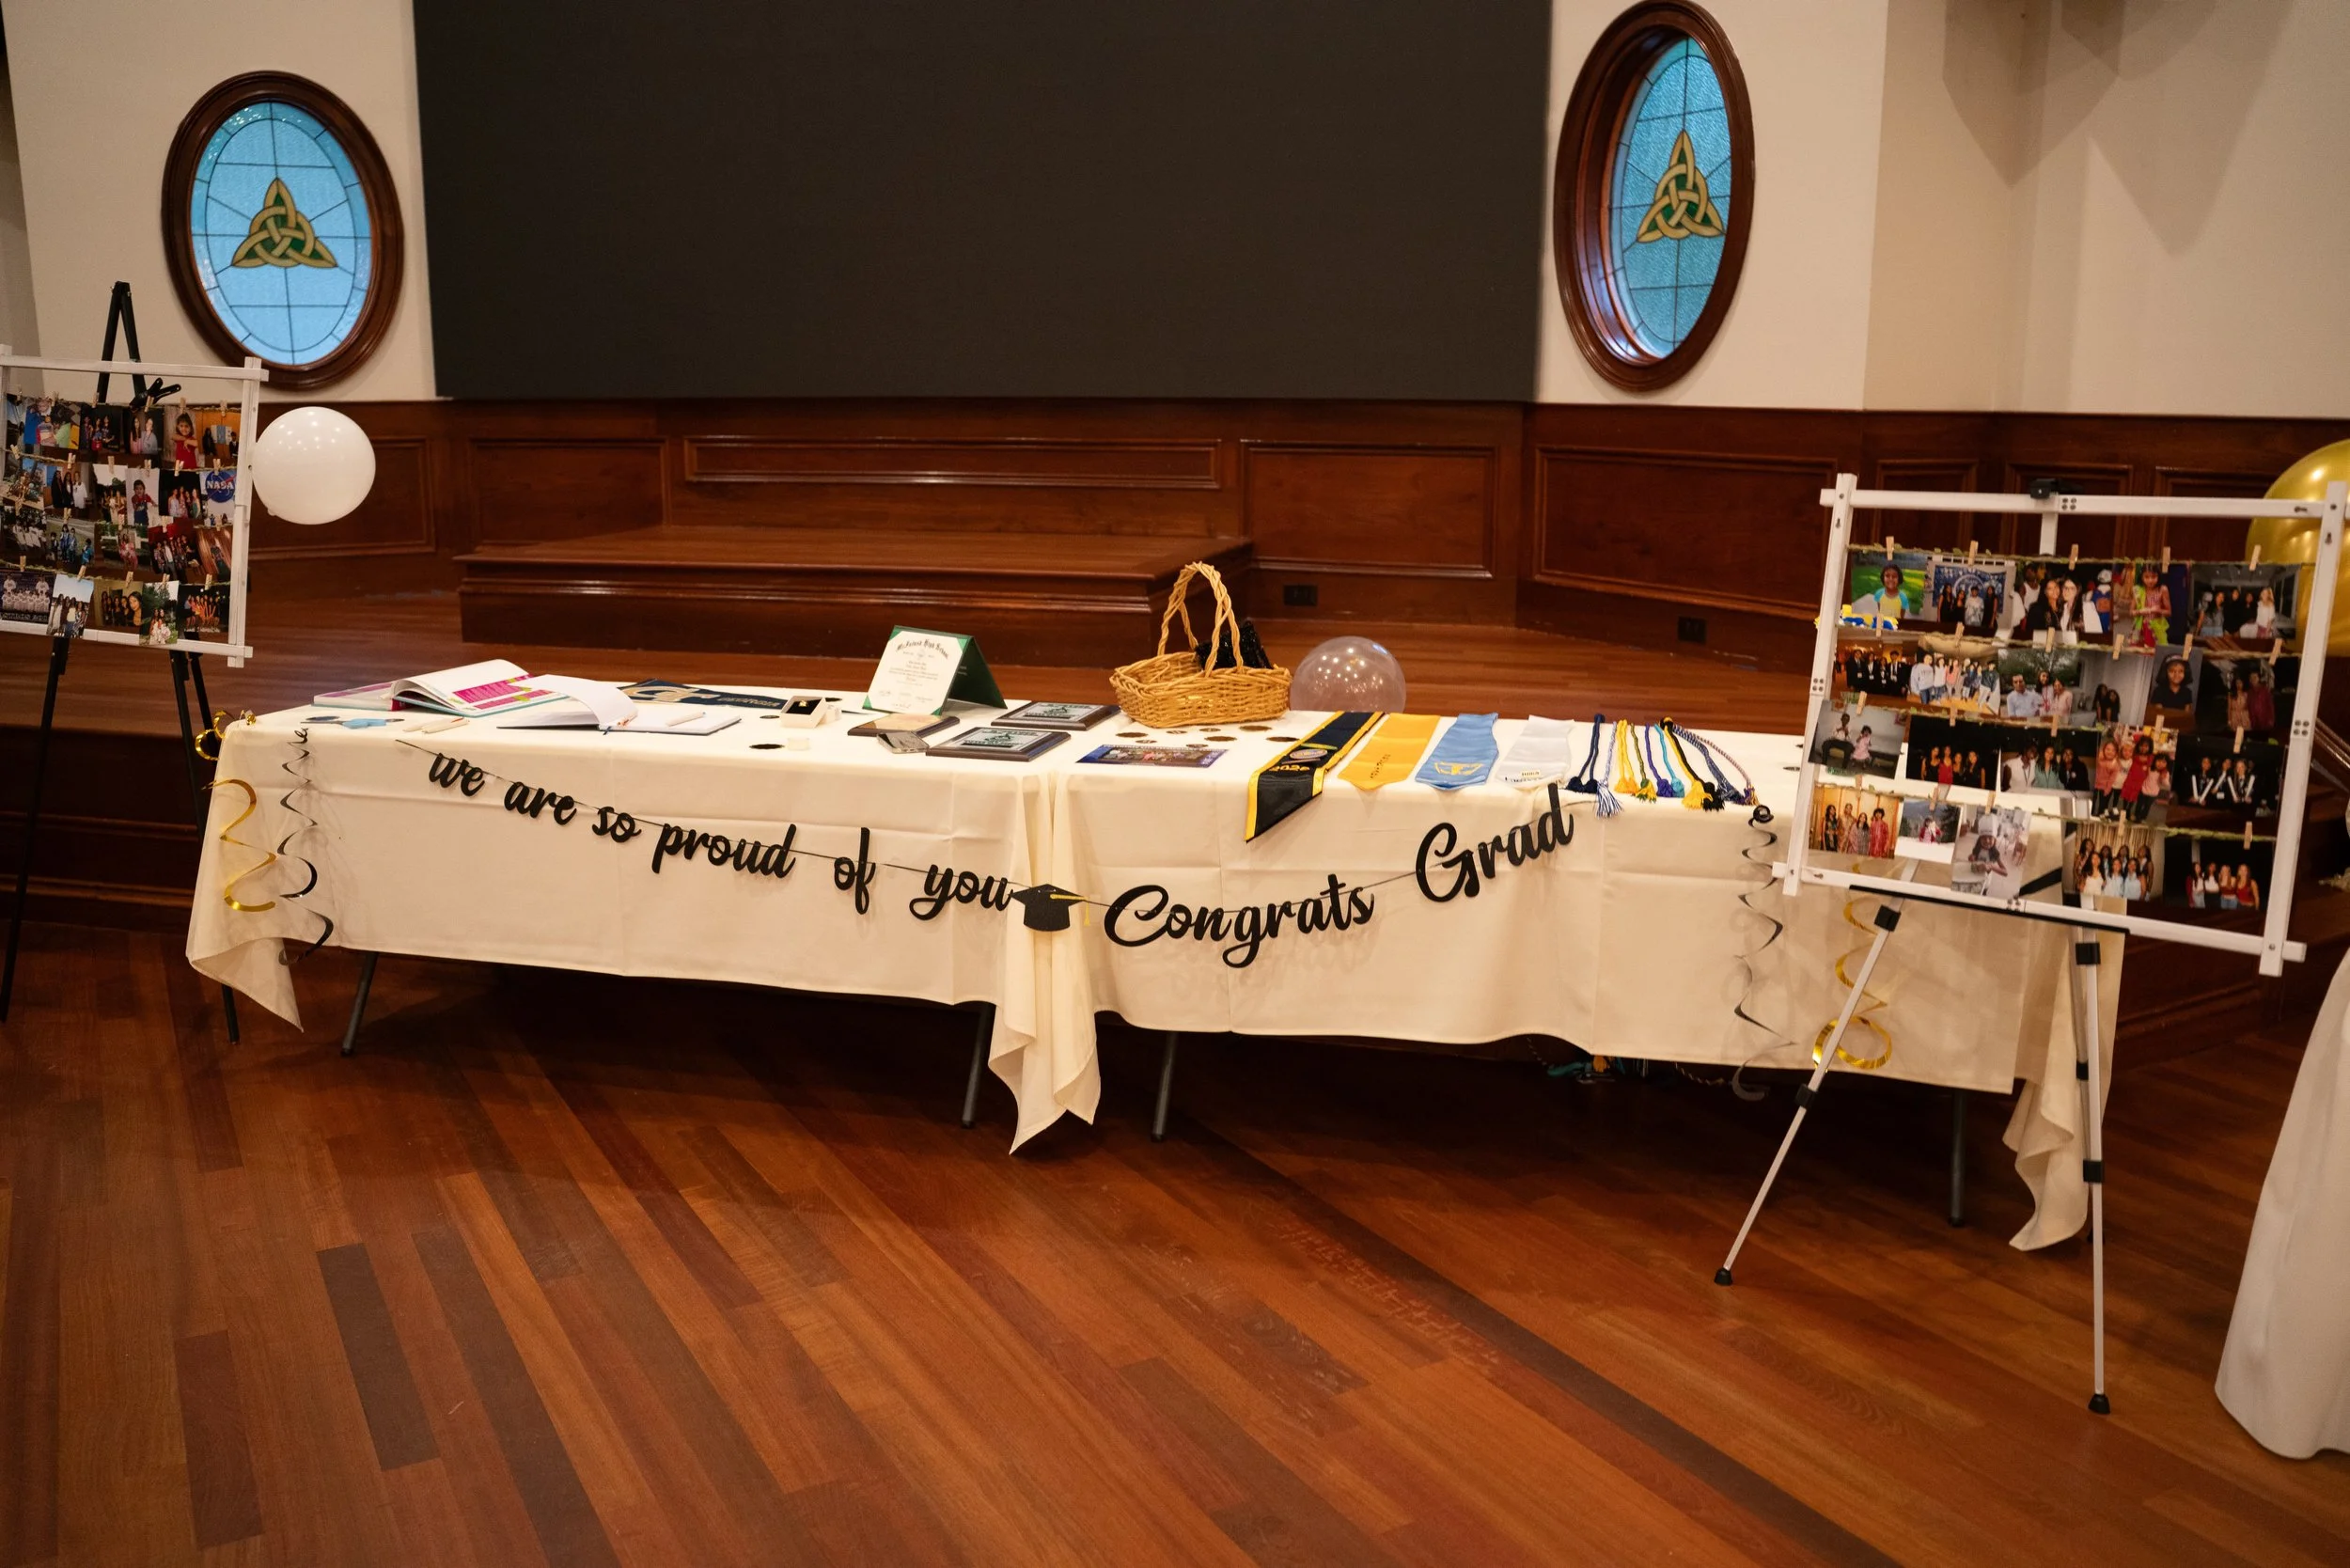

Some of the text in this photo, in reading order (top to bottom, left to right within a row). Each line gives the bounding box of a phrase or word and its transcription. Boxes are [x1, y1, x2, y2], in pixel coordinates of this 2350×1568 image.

[207, 480, 234, 490] NASA
[429, 752, 1014, 920] we are so proud of you
[1104, 782, 1574, 968] Congrats Grad
